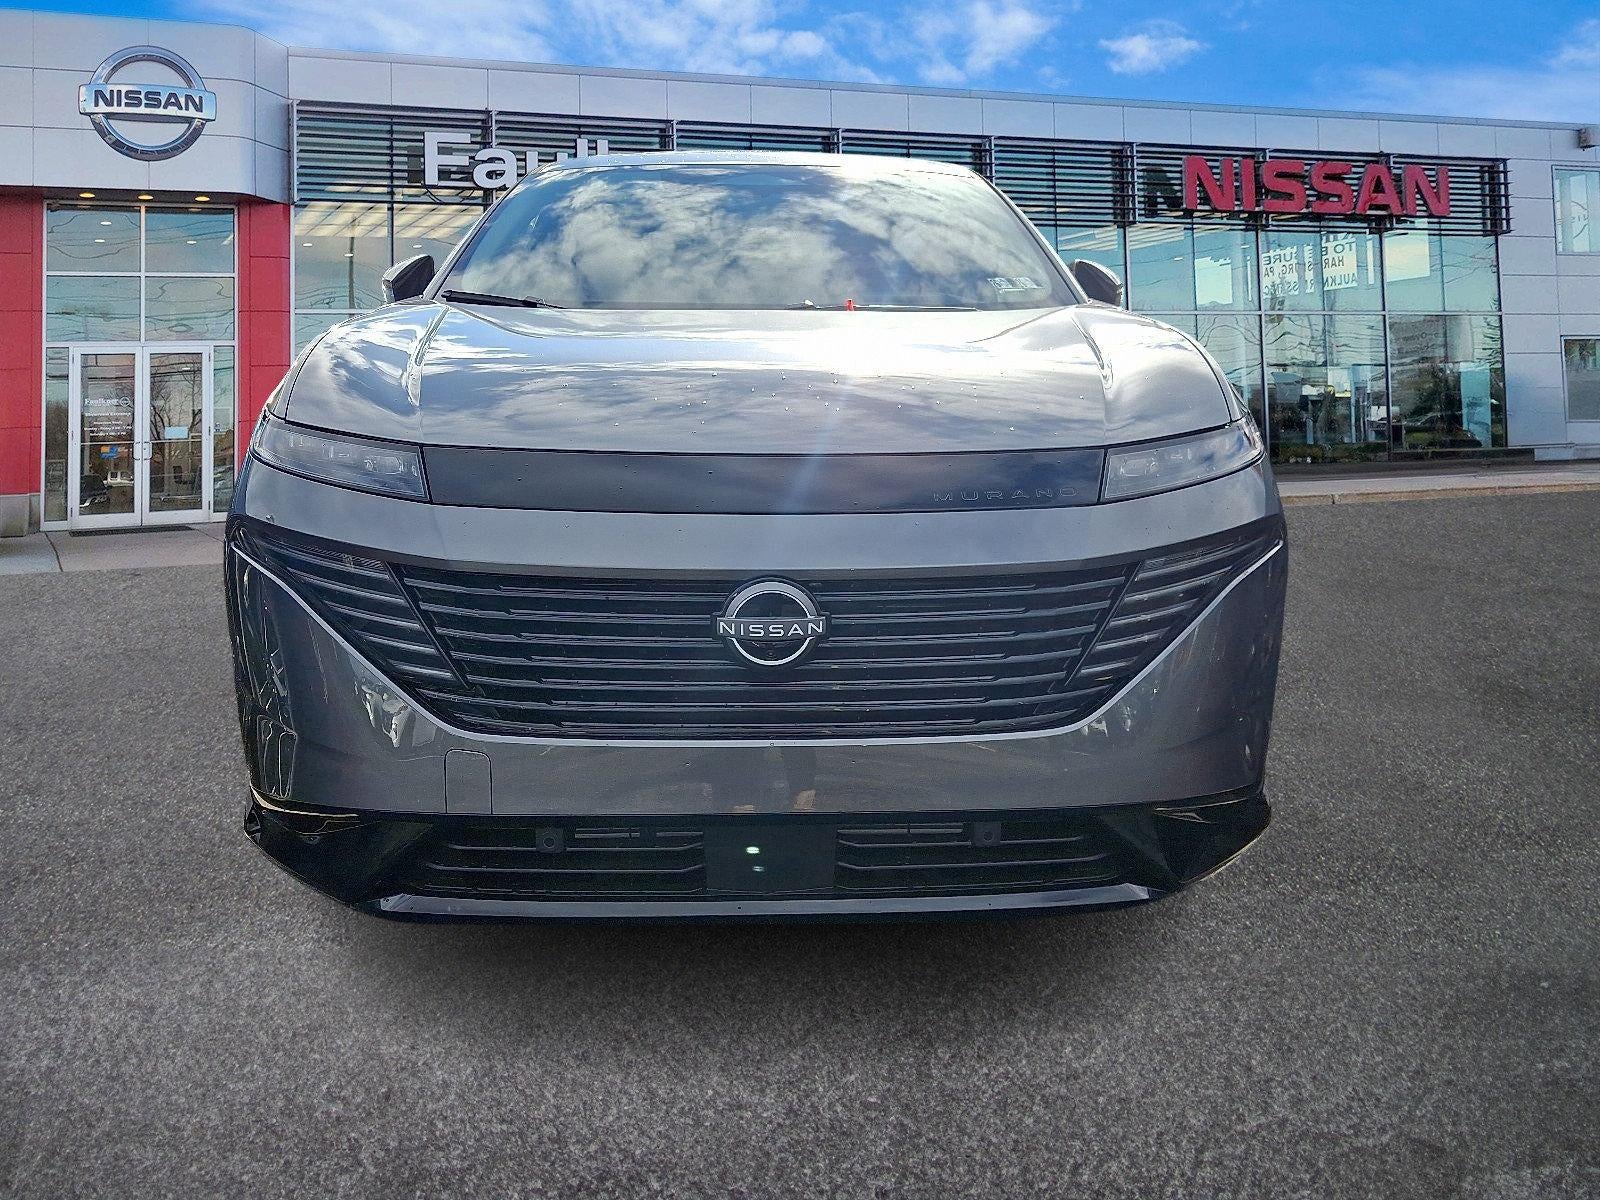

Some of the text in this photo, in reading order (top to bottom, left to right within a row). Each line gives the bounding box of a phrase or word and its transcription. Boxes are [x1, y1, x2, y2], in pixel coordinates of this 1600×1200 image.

[94, 89, 203, 113] NISSAN
[1182, 155, 1450, 217] NISSAN
[933, 487, 1079, 501] MURANO
[720, 621, 823, 637] NISSAN
